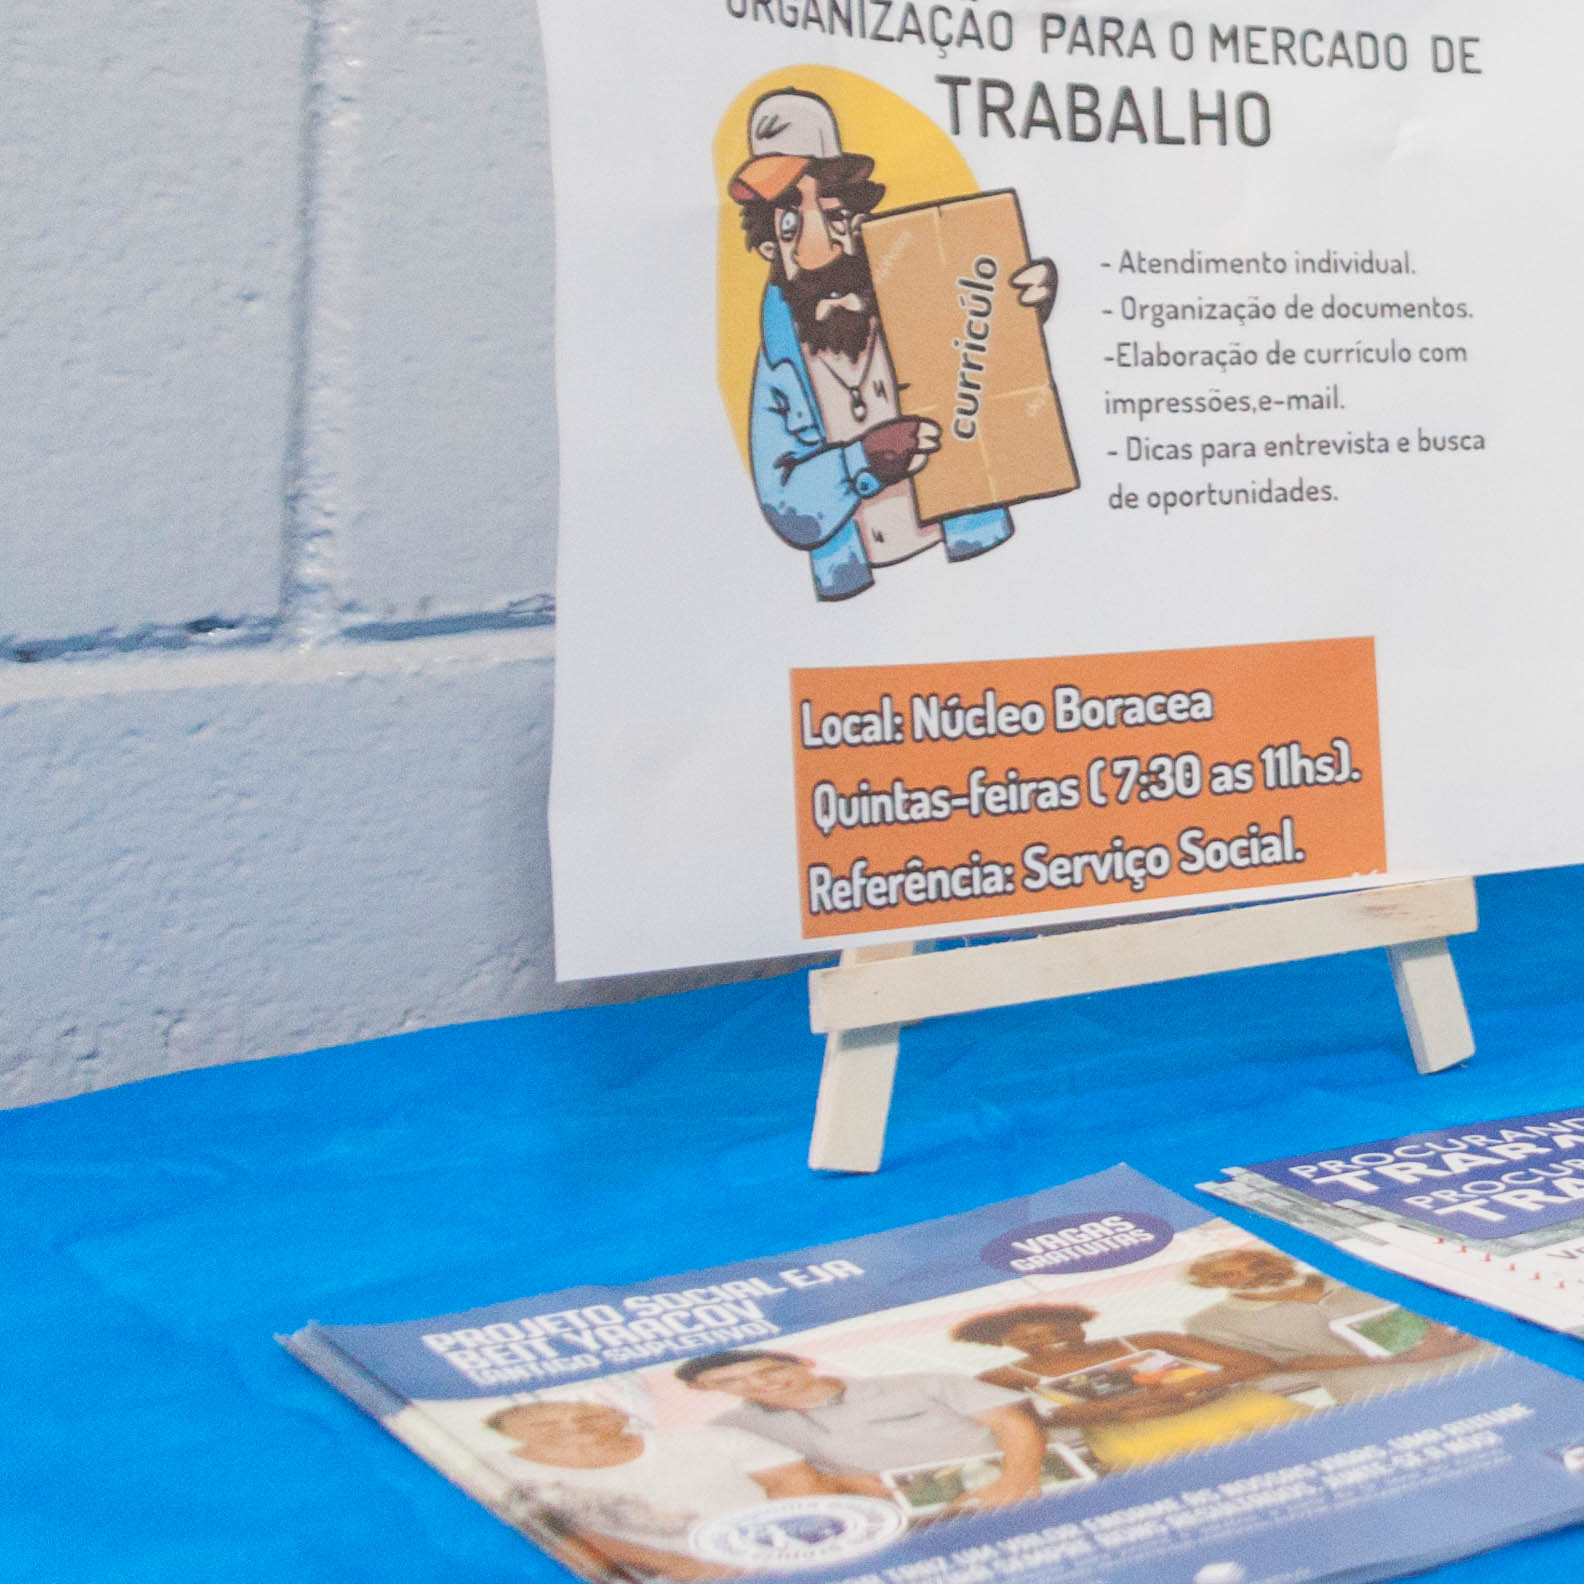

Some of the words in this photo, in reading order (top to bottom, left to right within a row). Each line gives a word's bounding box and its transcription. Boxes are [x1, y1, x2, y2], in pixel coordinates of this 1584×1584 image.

[1039, 12, 1157, 58] PARA
[1169, 19, 1194, 62] O
[1207, 22, 1409, 72] MERCADO
[1431, 33, 1483, 75] DE
[934, 73, 1271, 148] TRABALHO
[1118, 249, 1288, 275] Atendimento
[1295, 249, 1416, 275] individual.
[1120, 294, 1277, 327] Organização
[1284, 293, 1314, 319] de
[1321, 293, 1474, 319] documentos.
[1266, 339, 1297, 366] de
[1303, 337, 1413, 365] currículo
[1418, 342, 1468, 364] com
[1126, 435, 1193, 462] Dicas
[1201, 439, 1257, 468] para
[1263, 430, 1390, 458] entrevista
[1396, 435, 1410, 453] e
[1417, 427, 1487, 453] busca
[1108, 482, 1139, 510] de
[1146, 477, 1339, 515] oportunidades.
[801, 695, 904, 749] Local:
[911, 688, 1047, 742] Núcleo
[1052, 683, 1215, 733] Boracea
[811, 767, 1081, 835] Quintas-feiras
[1211, 761, 1254, 794] as
[807, 852, 1016, 914] Referência:
[1021, 837, 1171, 892] Serviço
[1177, 816, 1307, 874] Social.
[1010, 1216, 1136, 1254] VAGAS
[1010, 1228, 1155, 1271] GRATUITAS
[425, 1304, 624, 1348] PROJETO
[622, 1277, 788, 1317] SOCIAL
[778, 1260, 865, 1289] EJA
[449, 1333, 565, 1370] BEIT
